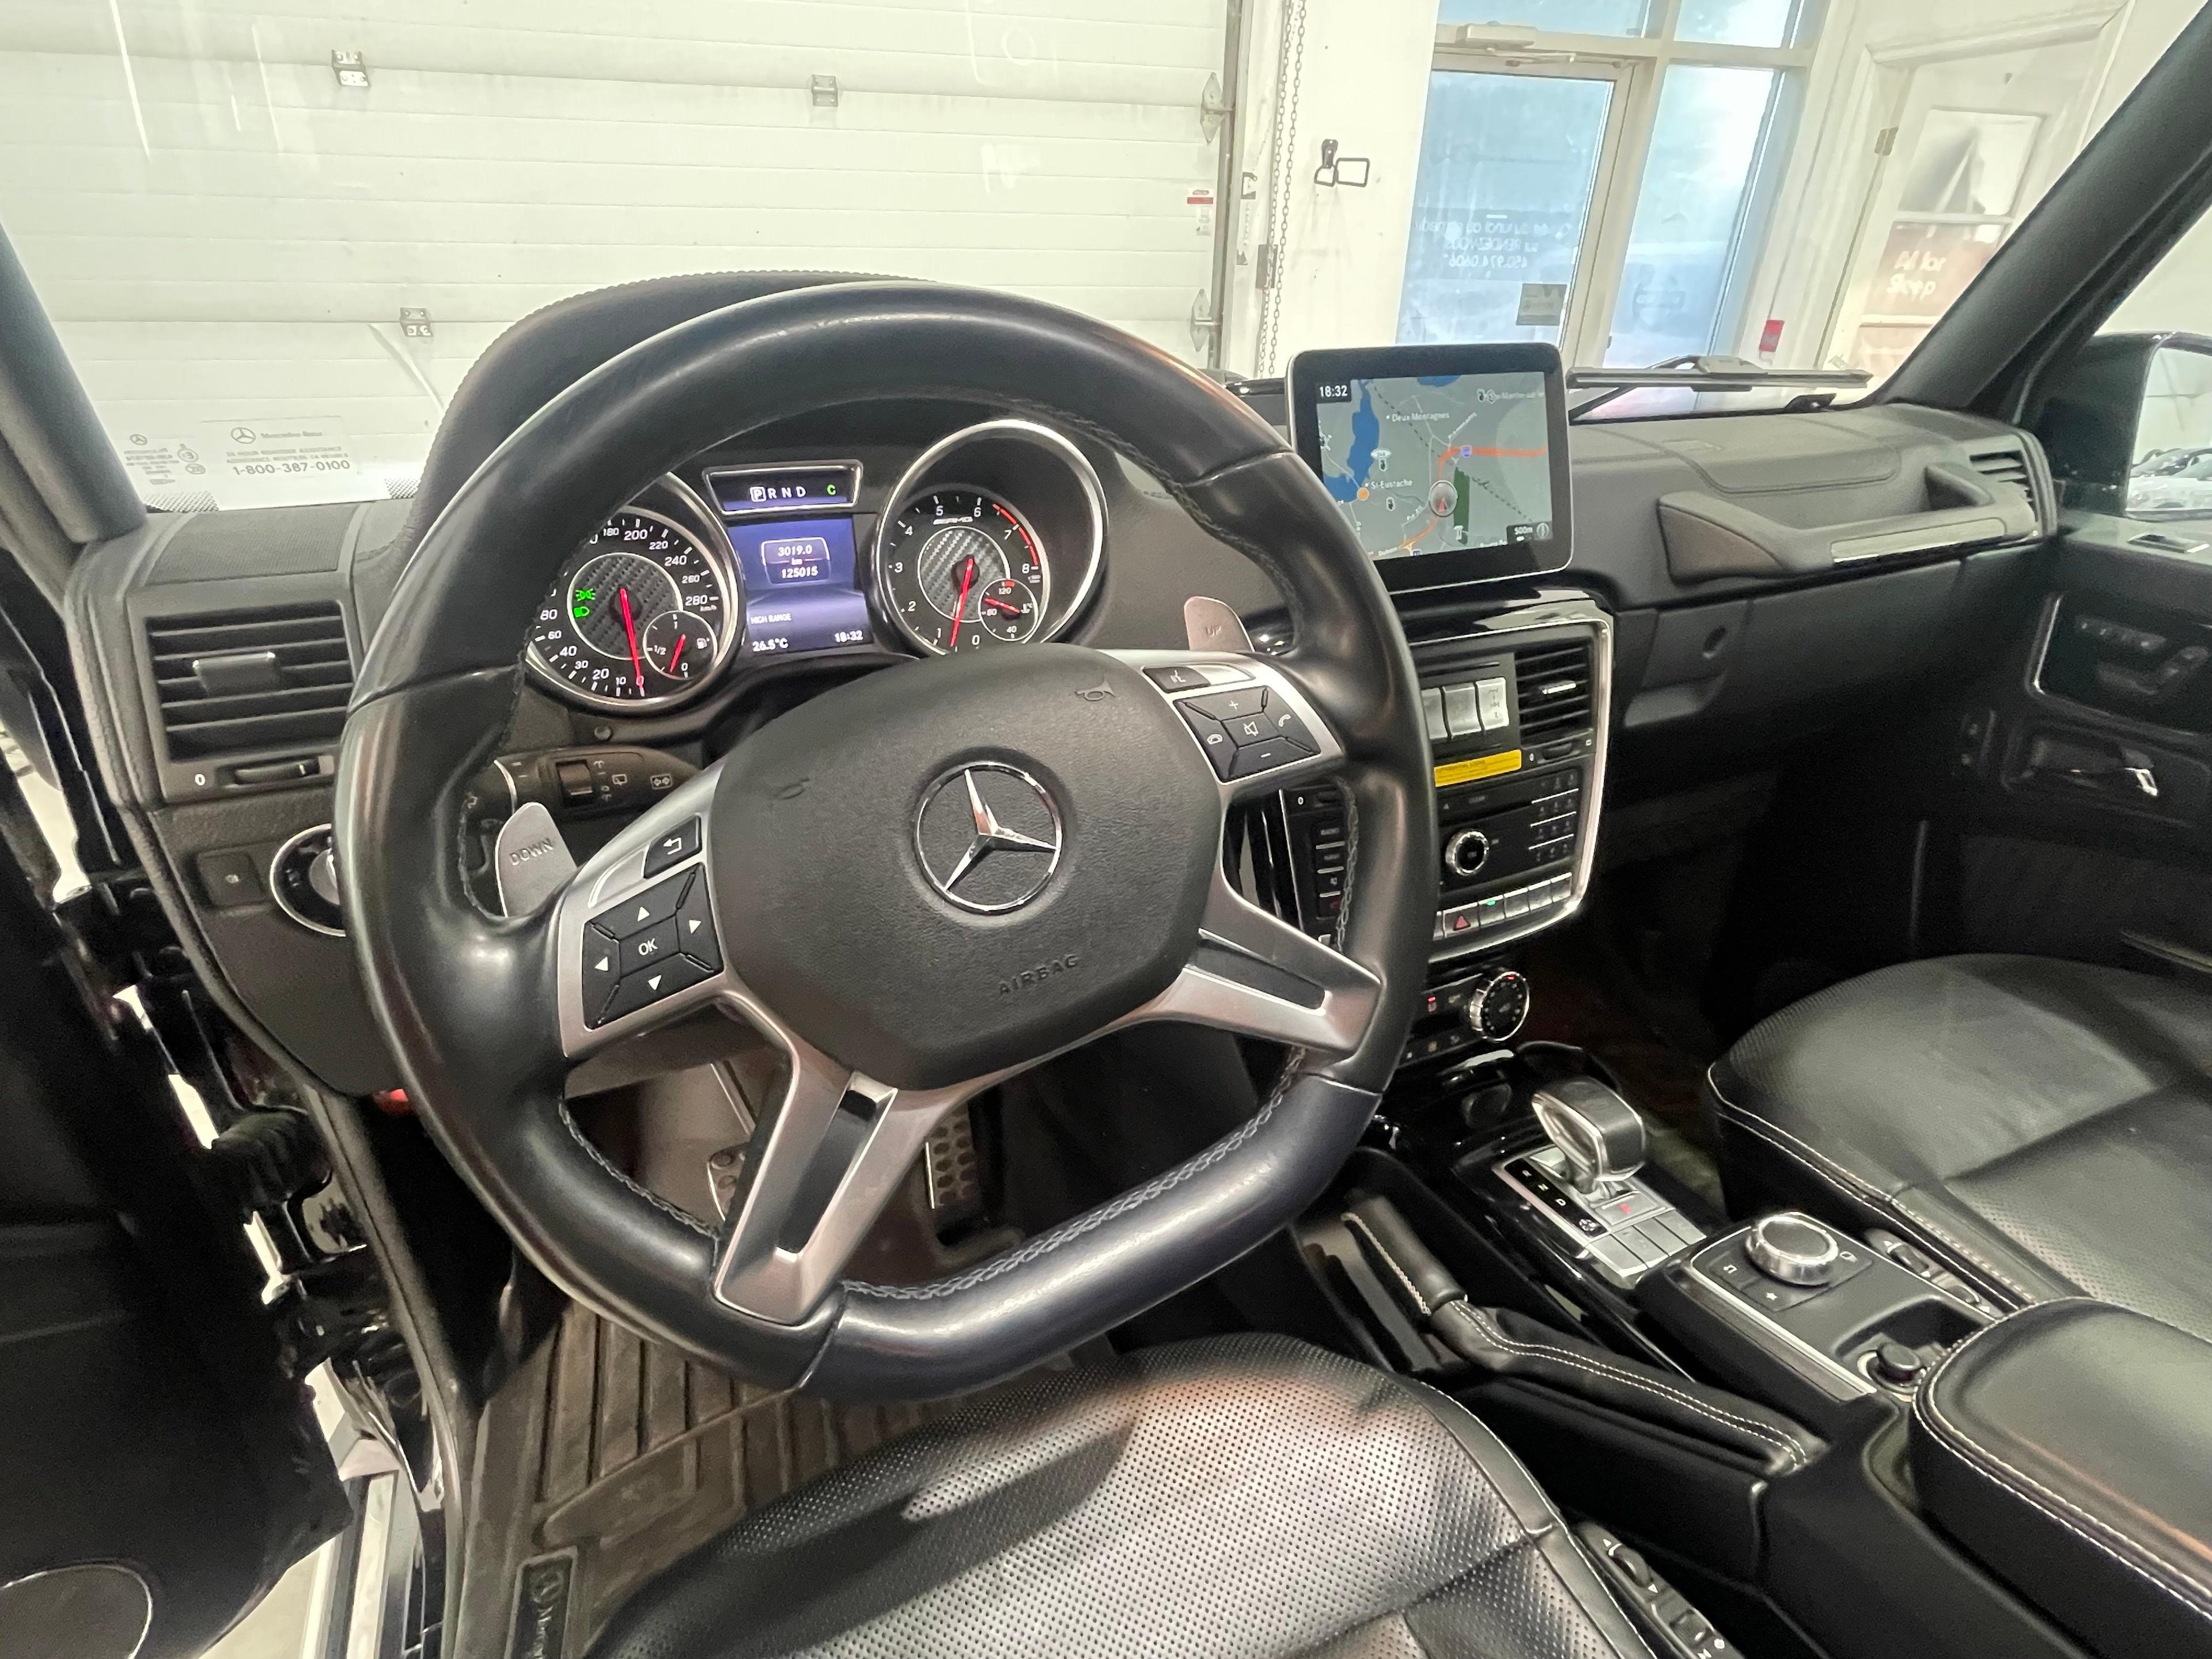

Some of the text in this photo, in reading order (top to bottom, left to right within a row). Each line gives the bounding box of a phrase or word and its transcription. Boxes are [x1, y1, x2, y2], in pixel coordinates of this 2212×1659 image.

[1319, 385, 1348, 398] 18:32
[233, 460, 350, 475] 1-800-387-0100
[767, 487, 777, 499] R
[782, 487, 792, 498] N
[796, 486, 806, 497] D
[827, 484, 836, 495] C
[935, 506, 944, 516] 5
[974, 507, 982, 517] 6
[603, 528, 619, 536] 180
[624, 529, 647, 540] 200
[904, 526, 913, 536] 4
[1004, 530, 1012, 540] 7
[649, 541, 668, 550] 220
[778, 544, 813, 557] 3019.0
[665, 555, 687, 566] 240
[781, 566, 818, 578] 125015
[895, 563, 903, 573] 3
[1022, 563, 1029, 573] 8
[682, 575, 700, 583] 260
[685, 595, 708, 605] 280
[908, 601, 915, 611] 2
[540, 609, 558, 620] 80
[548, 630, 562, 639] 60
[936, 628, 941, 638] 1
[1205, 625, 1222, 637] UP
[835, 630, 863, 643] 18:32
[972, 635, 980, 645] 0
[560, 646, 577, 657] 40
[653, 645, 666, 655] 1/2
[575, 660, 588, 669] 30
[681, 663, 688, 671] 0
[593, 668, 609, 680] 20
[616, 676, 626, 685] 10
[195, 774, 206, 786] 0
[509, 838, 554, 866] DOWN
[638, 938, 658, 956] OK
[998, 953, 1079, 995] AIRBAG
[1556, 1198, 1566, 1206] D
